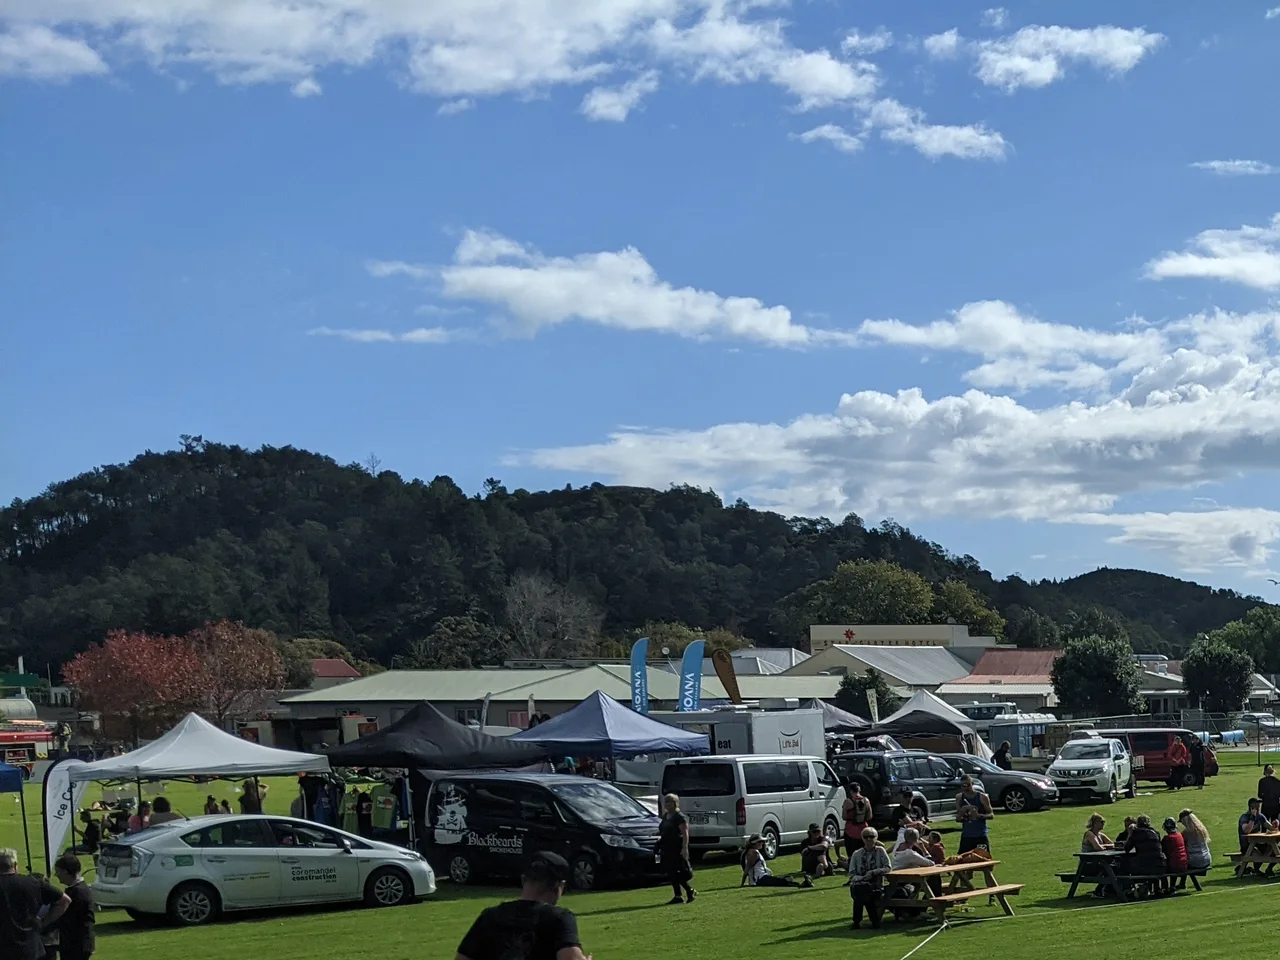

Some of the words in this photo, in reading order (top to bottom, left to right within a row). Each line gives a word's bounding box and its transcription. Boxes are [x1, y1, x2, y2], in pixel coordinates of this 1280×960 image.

[717, 739, 732, 749] eat
[53, 803, 68, 820] Ice
[62, 780, 77, 801] Cre
[292, 866, 336, 876] coromandel
[292, 873, 337, 882] construction
